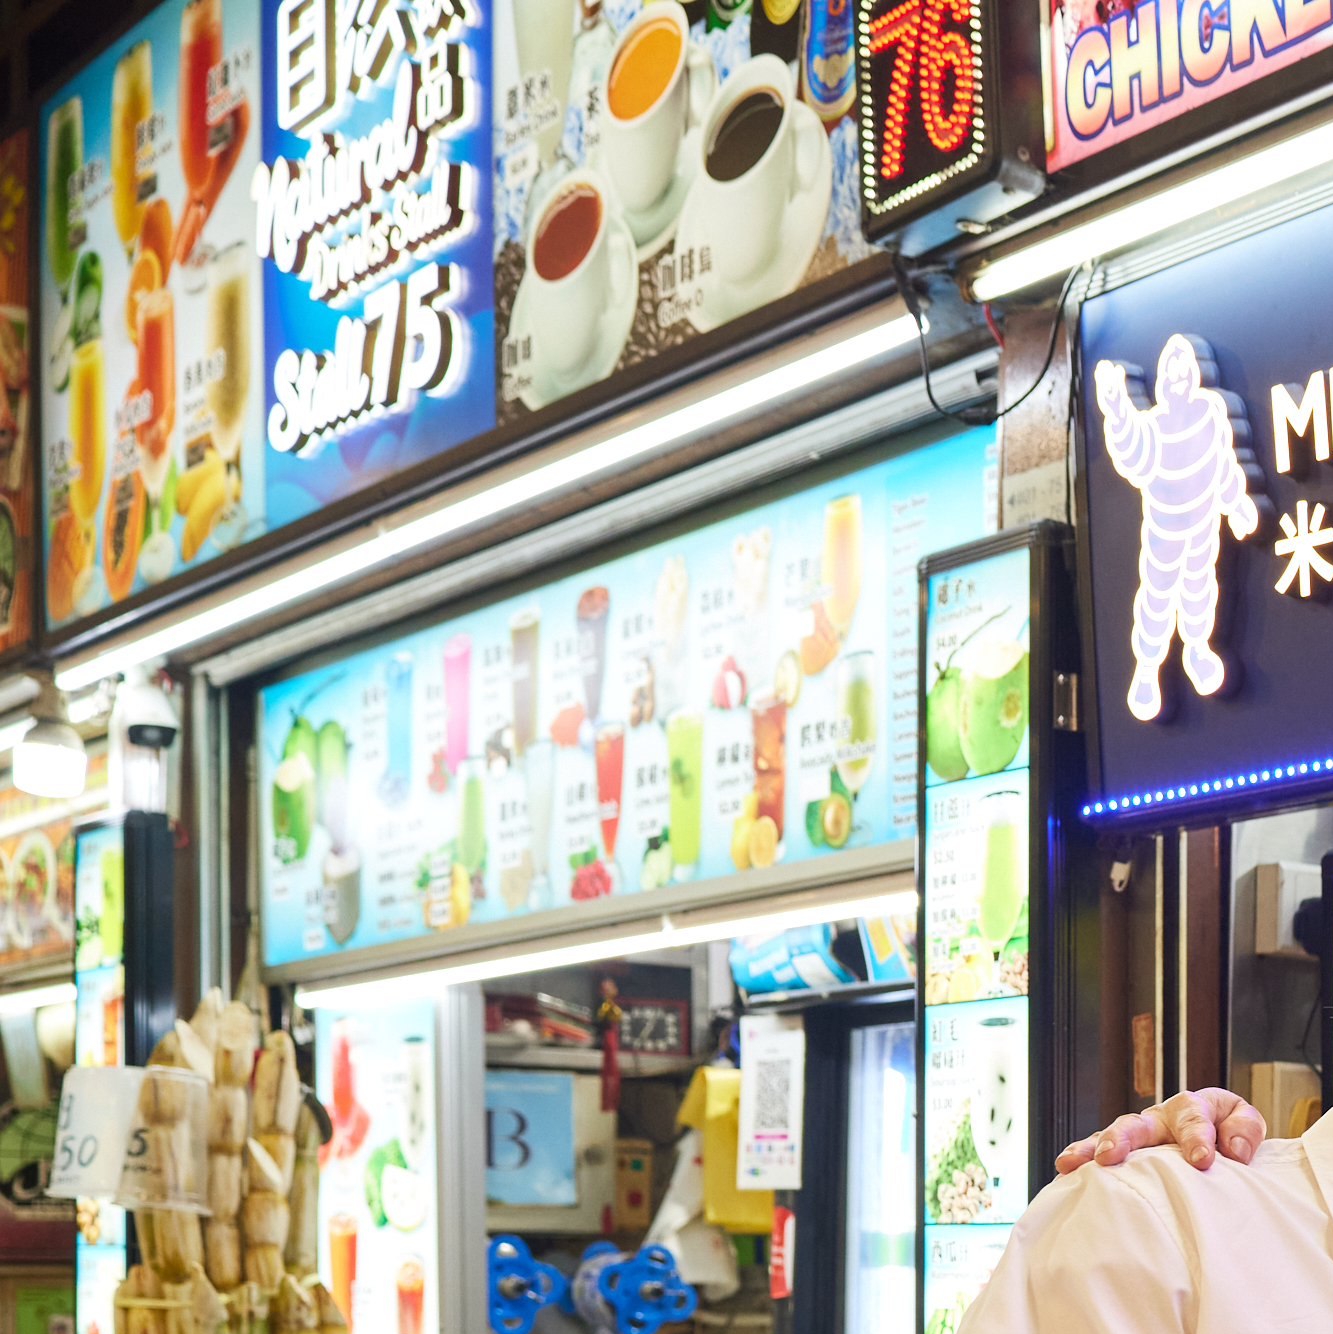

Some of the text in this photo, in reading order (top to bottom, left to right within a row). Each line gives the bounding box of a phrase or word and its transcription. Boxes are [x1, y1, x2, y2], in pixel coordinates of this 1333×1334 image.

[252, 58, 418, 273] Natural
[309, 158, 452, 302] Drinks Stall
[268, 313, 370, 454] Stall
[364, 261, 441, 408] 75
